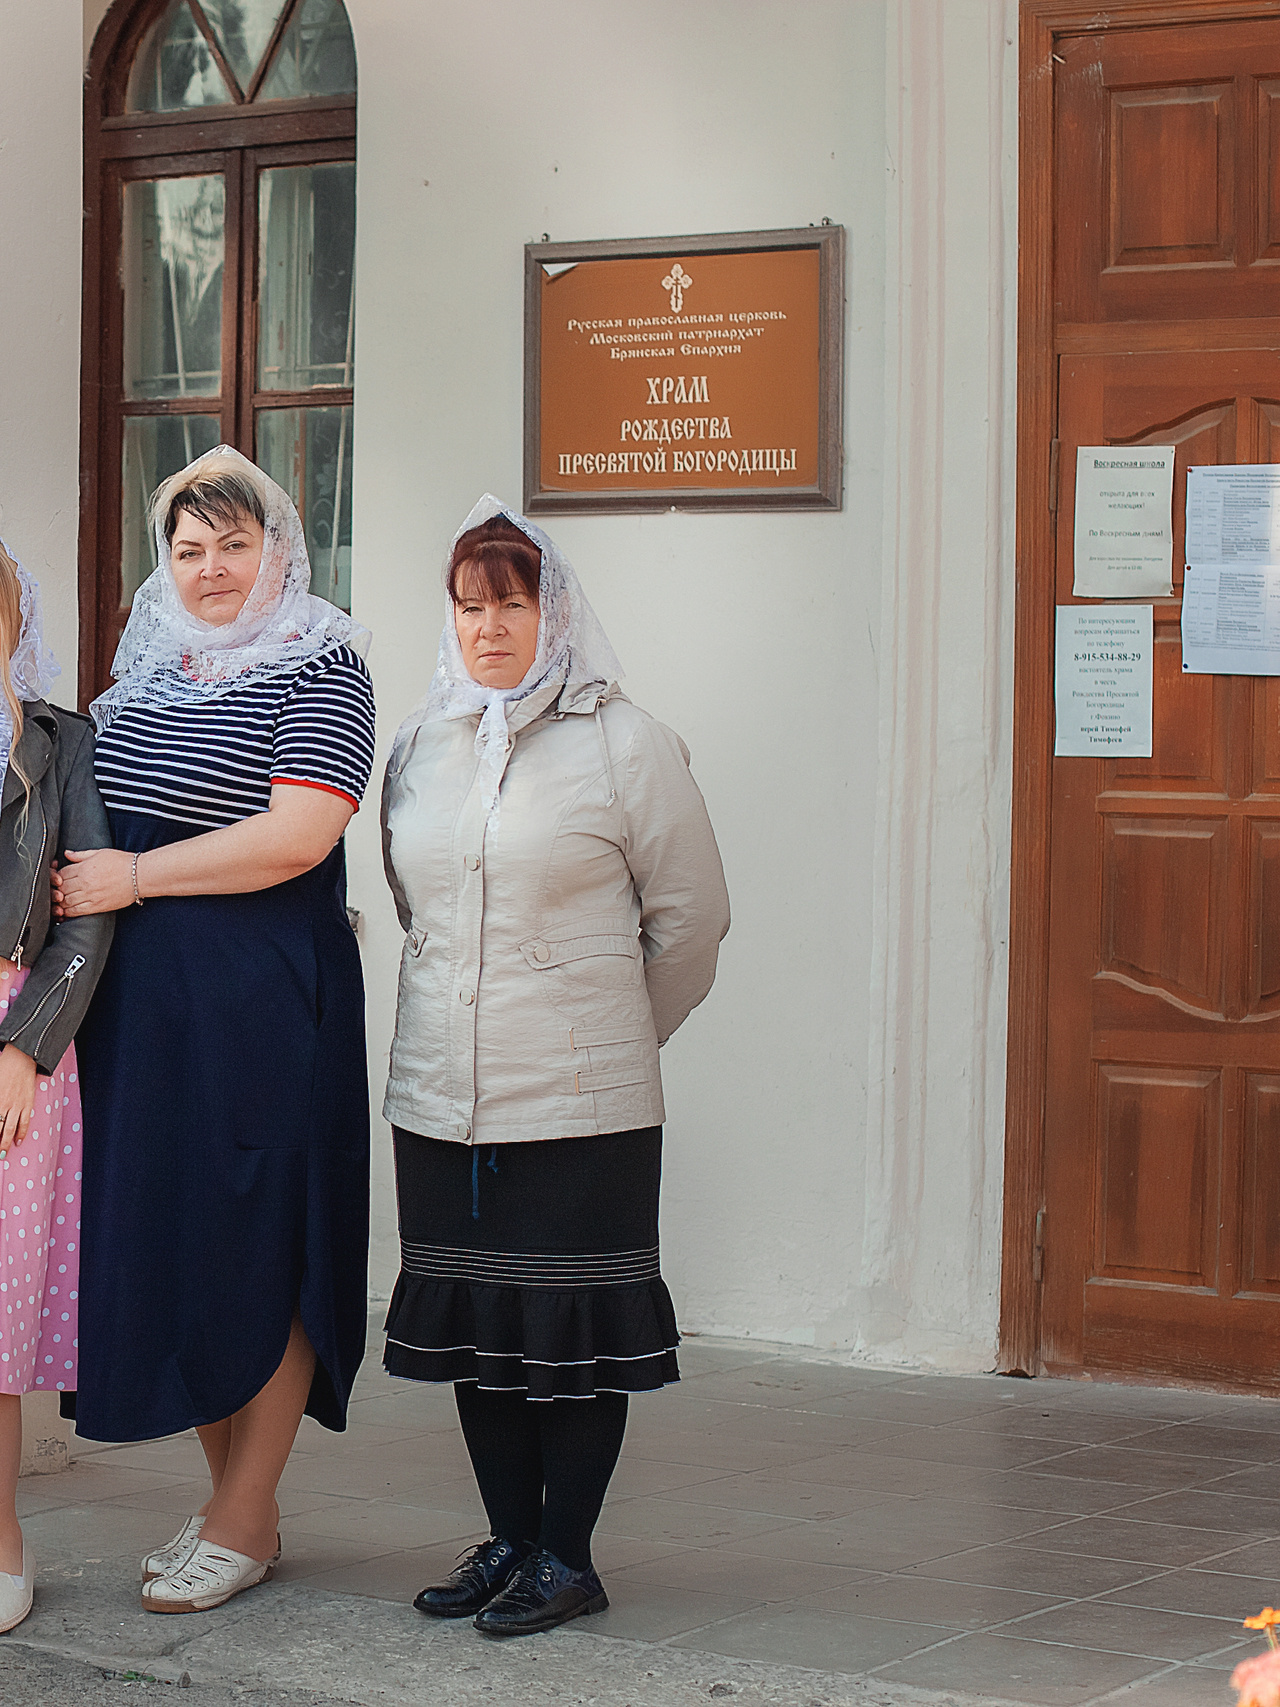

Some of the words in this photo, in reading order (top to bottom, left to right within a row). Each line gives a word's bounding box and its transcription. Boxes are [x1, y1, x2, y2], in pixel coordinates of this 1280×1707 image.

[568, 318, 622, 333] Русская
[628, 312, 724, 330] православная
[729, 310, 787, 324] церковь
[589, 330, 673, 345] Московский
[678, 326, 765, 342] патриархат
[610, 346, 675, 361] Брянская
[680, 343, 741, 358] Епархия
[646, 376, 710, 404] ХРАМ
[620, 416, 732, 445] РОЖДЕСТВА
[558, 447, 667, 475] ПРЕСВЯТОЙ
[672, 448, 797, 476] БОГОРОДИЦЫ
[1093, 459, 1138, 468] Воскресная
[1100, 530, 1141, 538] Воскресным
[1142, 530, 1163, 538] дням!
[1103, 628, 1140, 636] обращаться
[1096, 640, 1125, 648] телефону
[1074, 653, 1141, 661] 8-915-534-88-29
[1086, 701, 1124, 709] Богородицы
